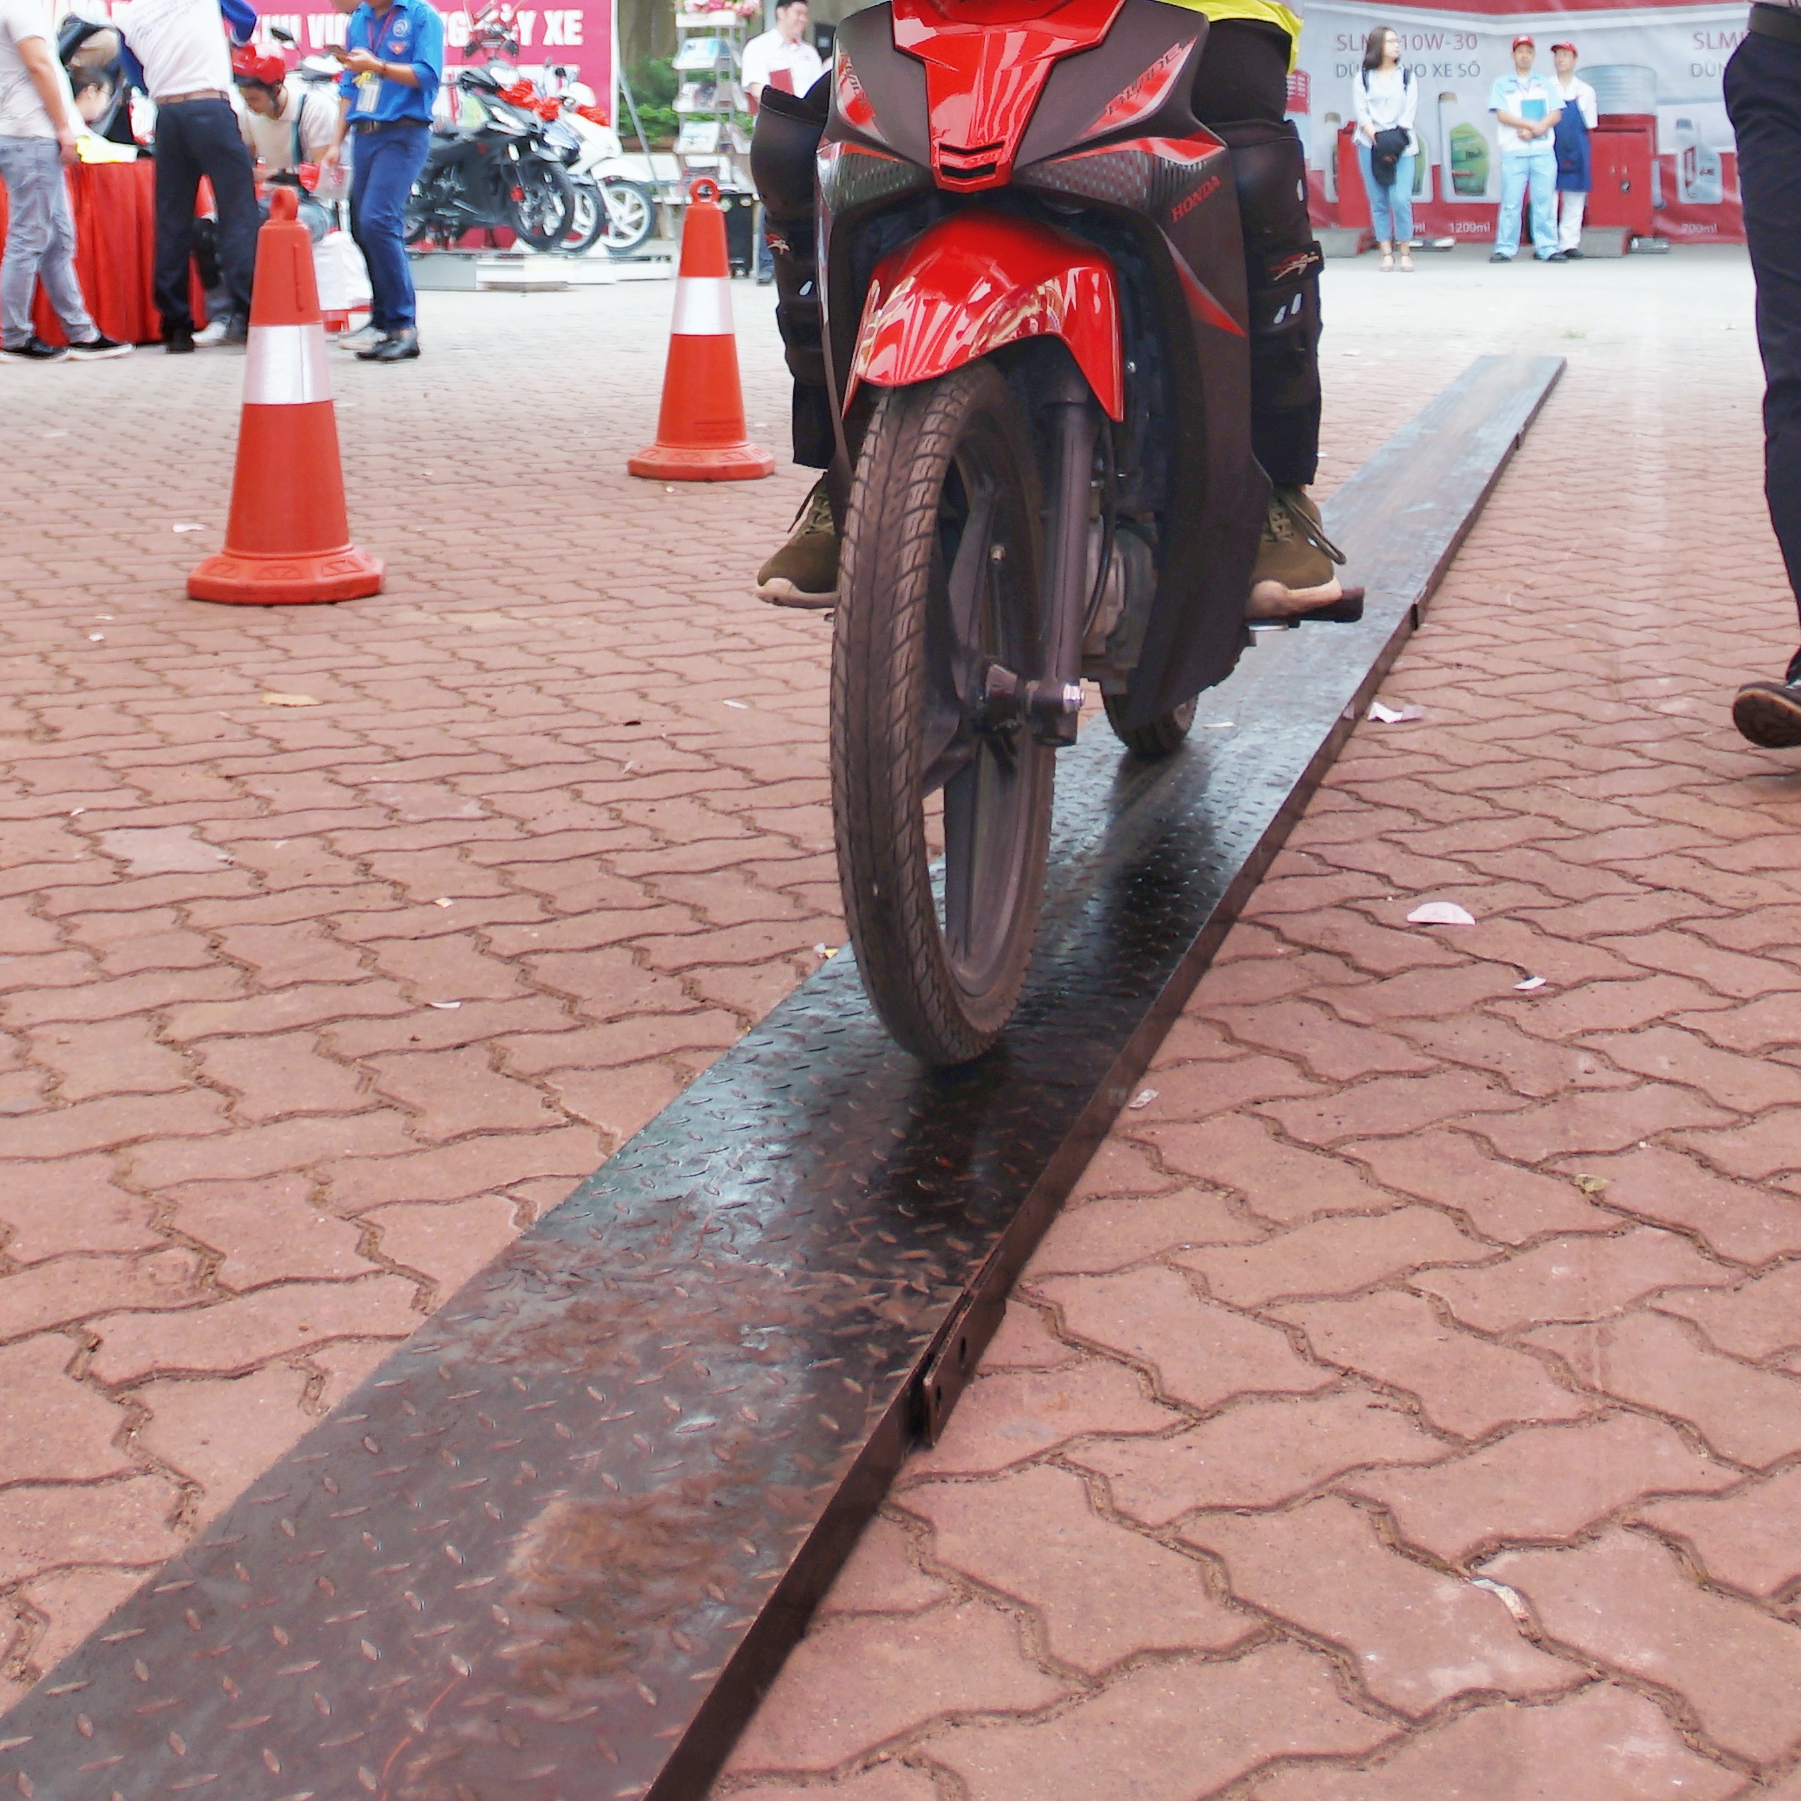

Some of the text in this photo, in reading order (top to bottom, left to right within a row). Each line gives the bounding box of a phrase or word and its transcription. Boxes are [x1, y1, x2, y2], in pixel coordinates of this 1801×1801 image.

[542, 8, 584, 47] XE
[1692, 31, 1751, 50] SLM
[1431, 63, 1453, 78] XE
[1170, 174, 1222, 223] HONDA
